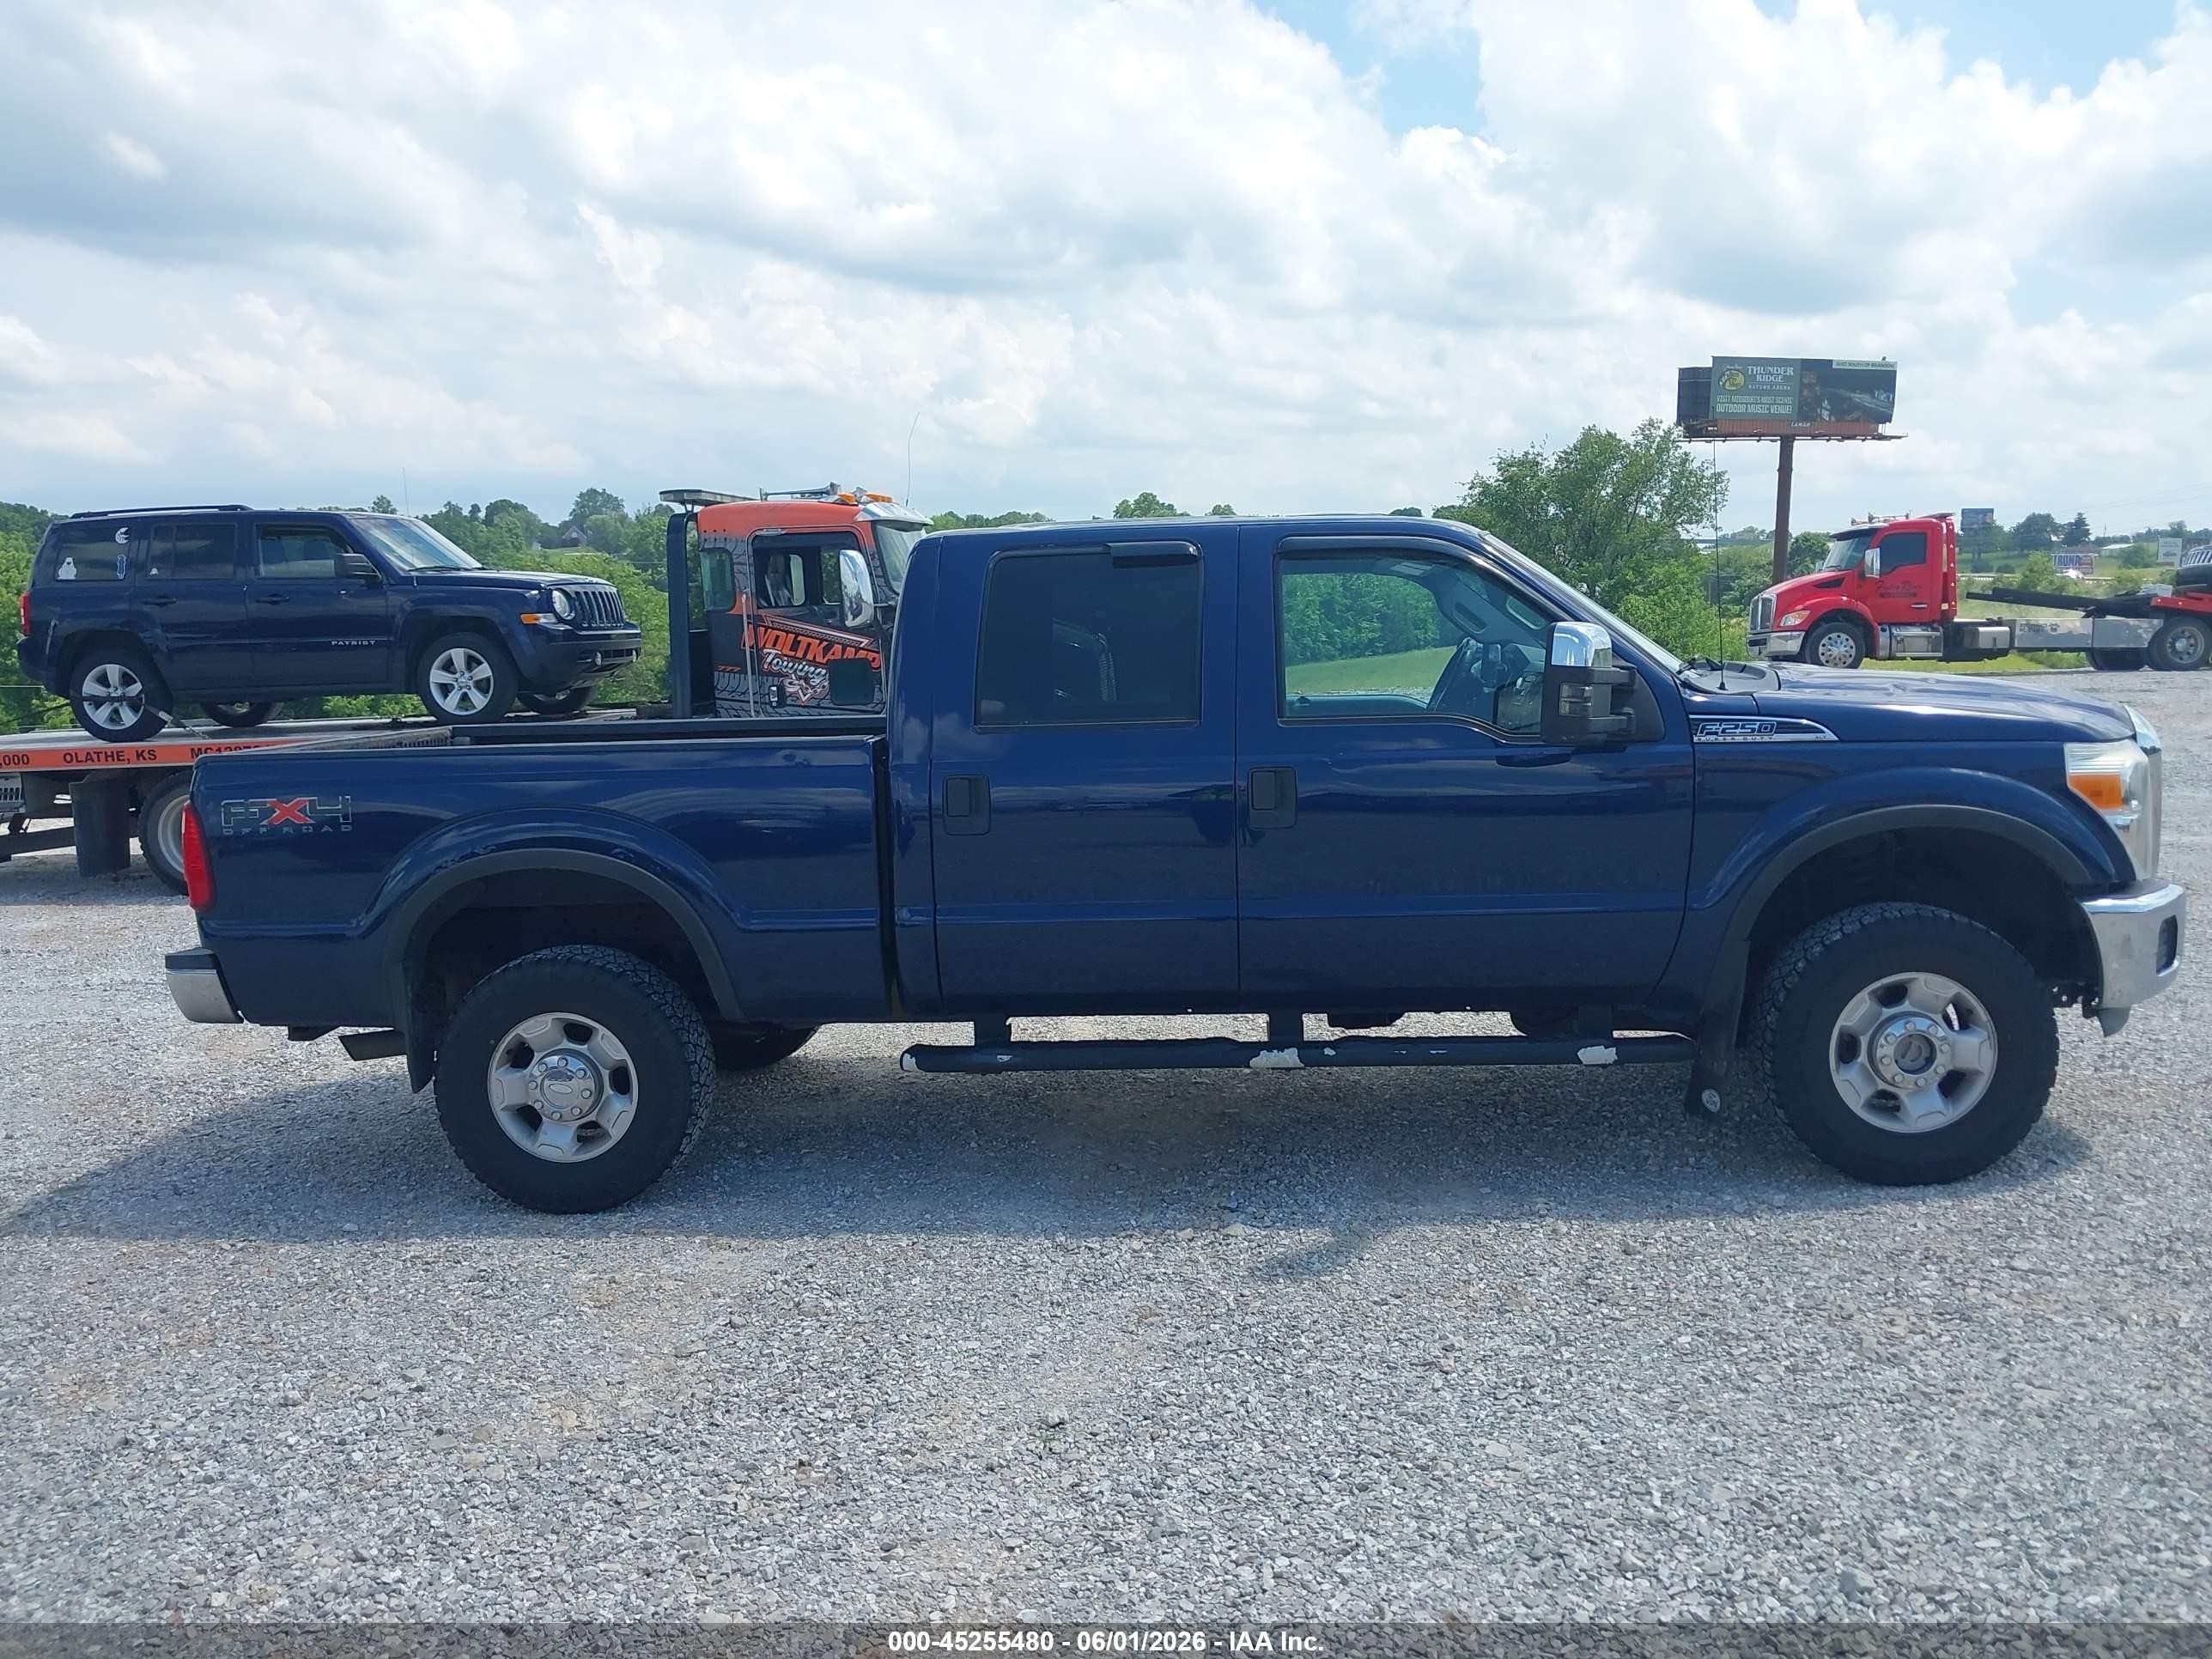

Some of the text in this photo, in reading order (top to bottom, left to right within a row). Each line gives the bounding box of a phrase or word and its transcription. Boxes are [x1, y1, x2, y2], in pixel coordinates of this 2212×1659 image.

[1747, 366, 1794, 375] THUNDER
[1716, 404, 1792, 414] OUTDOOR MUSIC VENUE!
[763, 649, 829, 686] Towing
[1697, 721, 1778, 737] F-250
[63, 748, 131, 765] OLATHE,
[136, 749, 157, 762] KS
[221, 795, 352, 827] FX4
[222, 824, 353, 836] OFF ROAD
